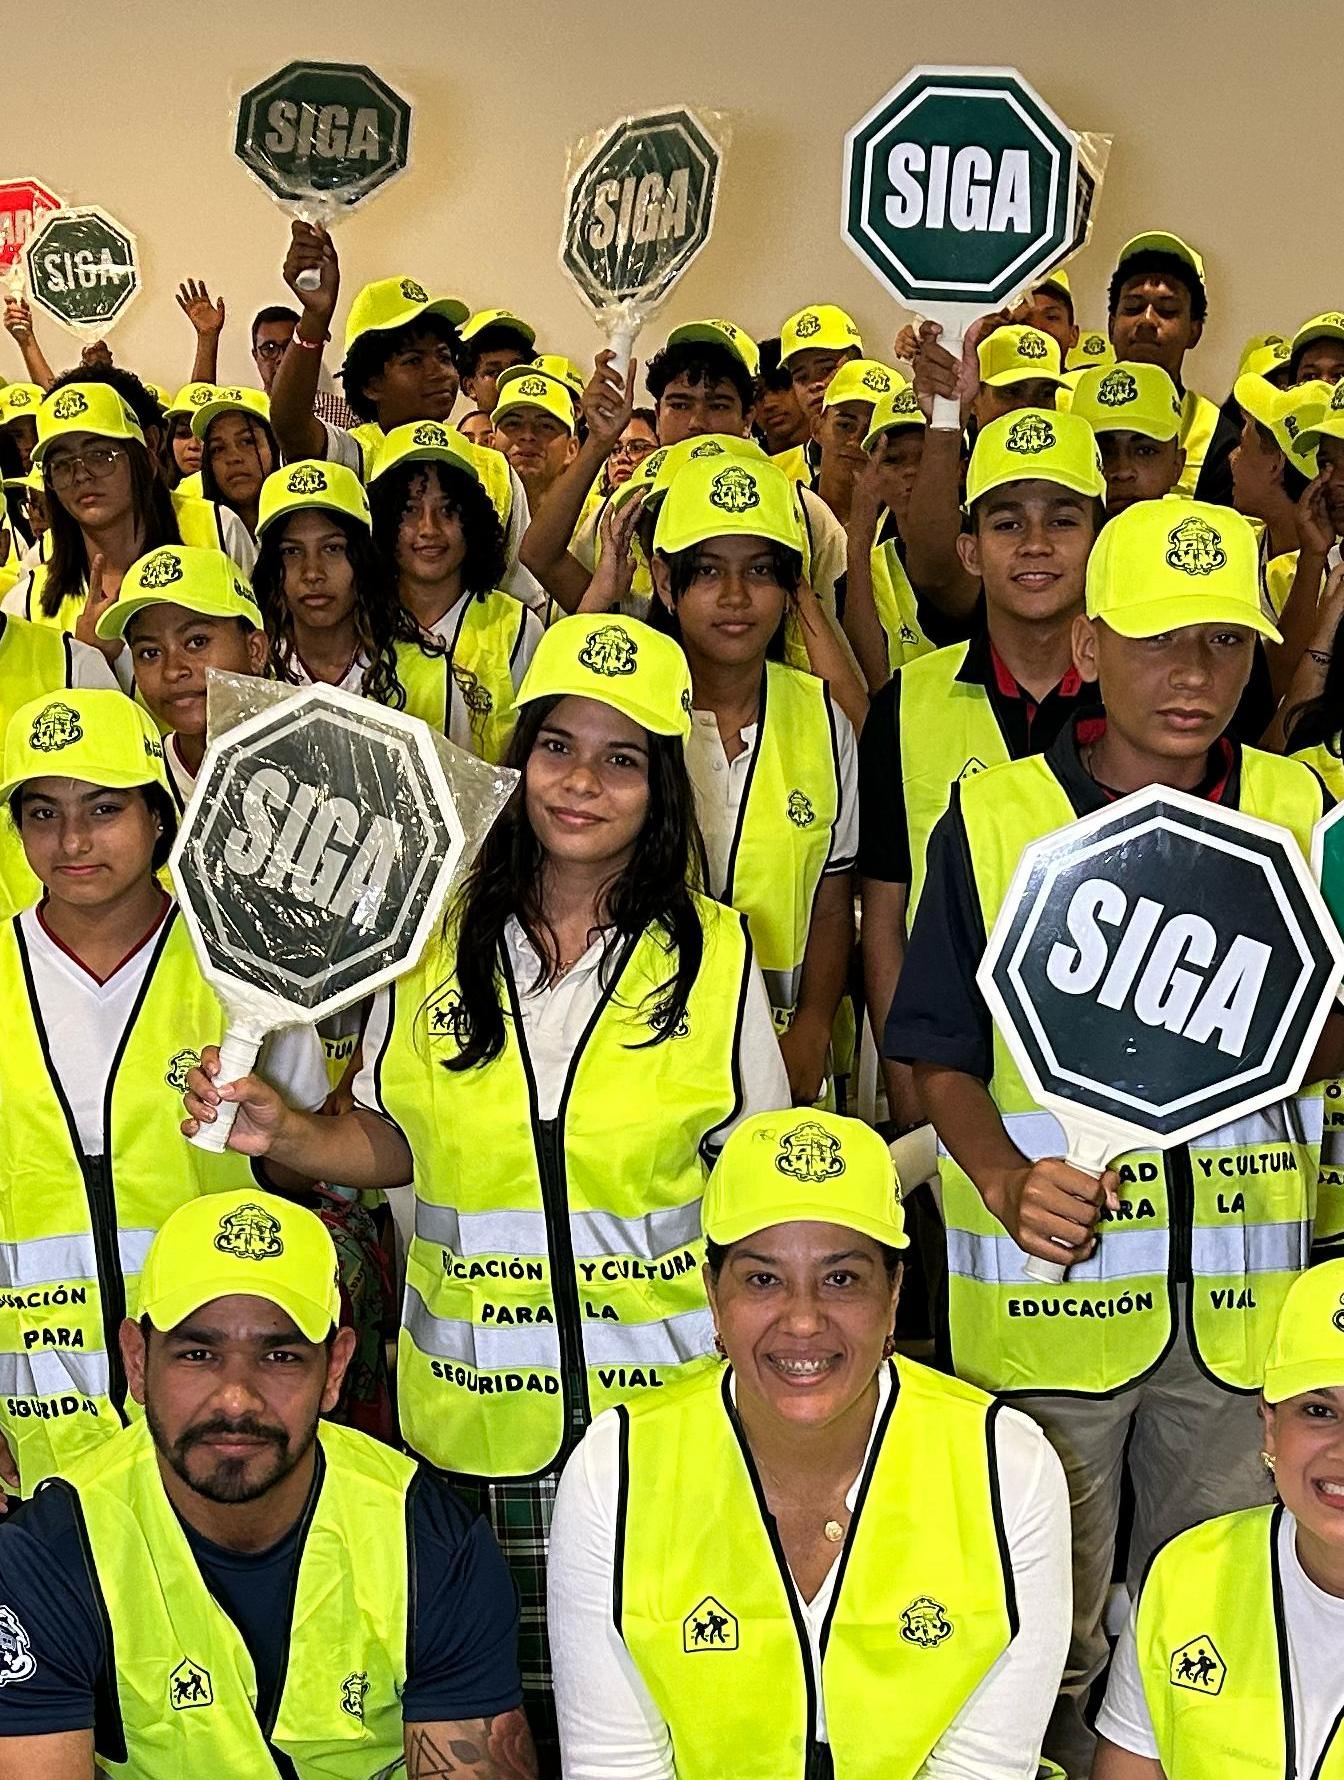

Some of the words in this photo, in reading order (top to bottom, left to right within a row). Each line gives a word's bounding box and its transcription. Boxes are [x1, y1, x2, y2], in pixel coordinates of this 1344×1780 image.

[266, 100, 381, 162] SIGA
[885, 142, 1032, 235] SIGA
[588, 166, 689, 251] SIGA
[43, 248, 120, 292] SIGA
[223, 768, 403, 936] SIGA
[1046, 878, 1273, 1058] SIGA
[1102, 1198, 1156, 1222] ARA
[1217, 1193, 1246, 1214] LA
[601, 1250, 697, 1282] CULTURA
[481, 1303, 554, 1324] PARA
[585, 1301, 620, 1322] LA
[1008, 1290, 1154, 1318] EDUCACIÓN
[1210, 1287, 1257, 1310] VIAL
[23, 1327, 84, 1350] PARA
[430, 1360, 560, 1395] SEGURIDAD
[598, 1368, 664, 1389] VIAL
